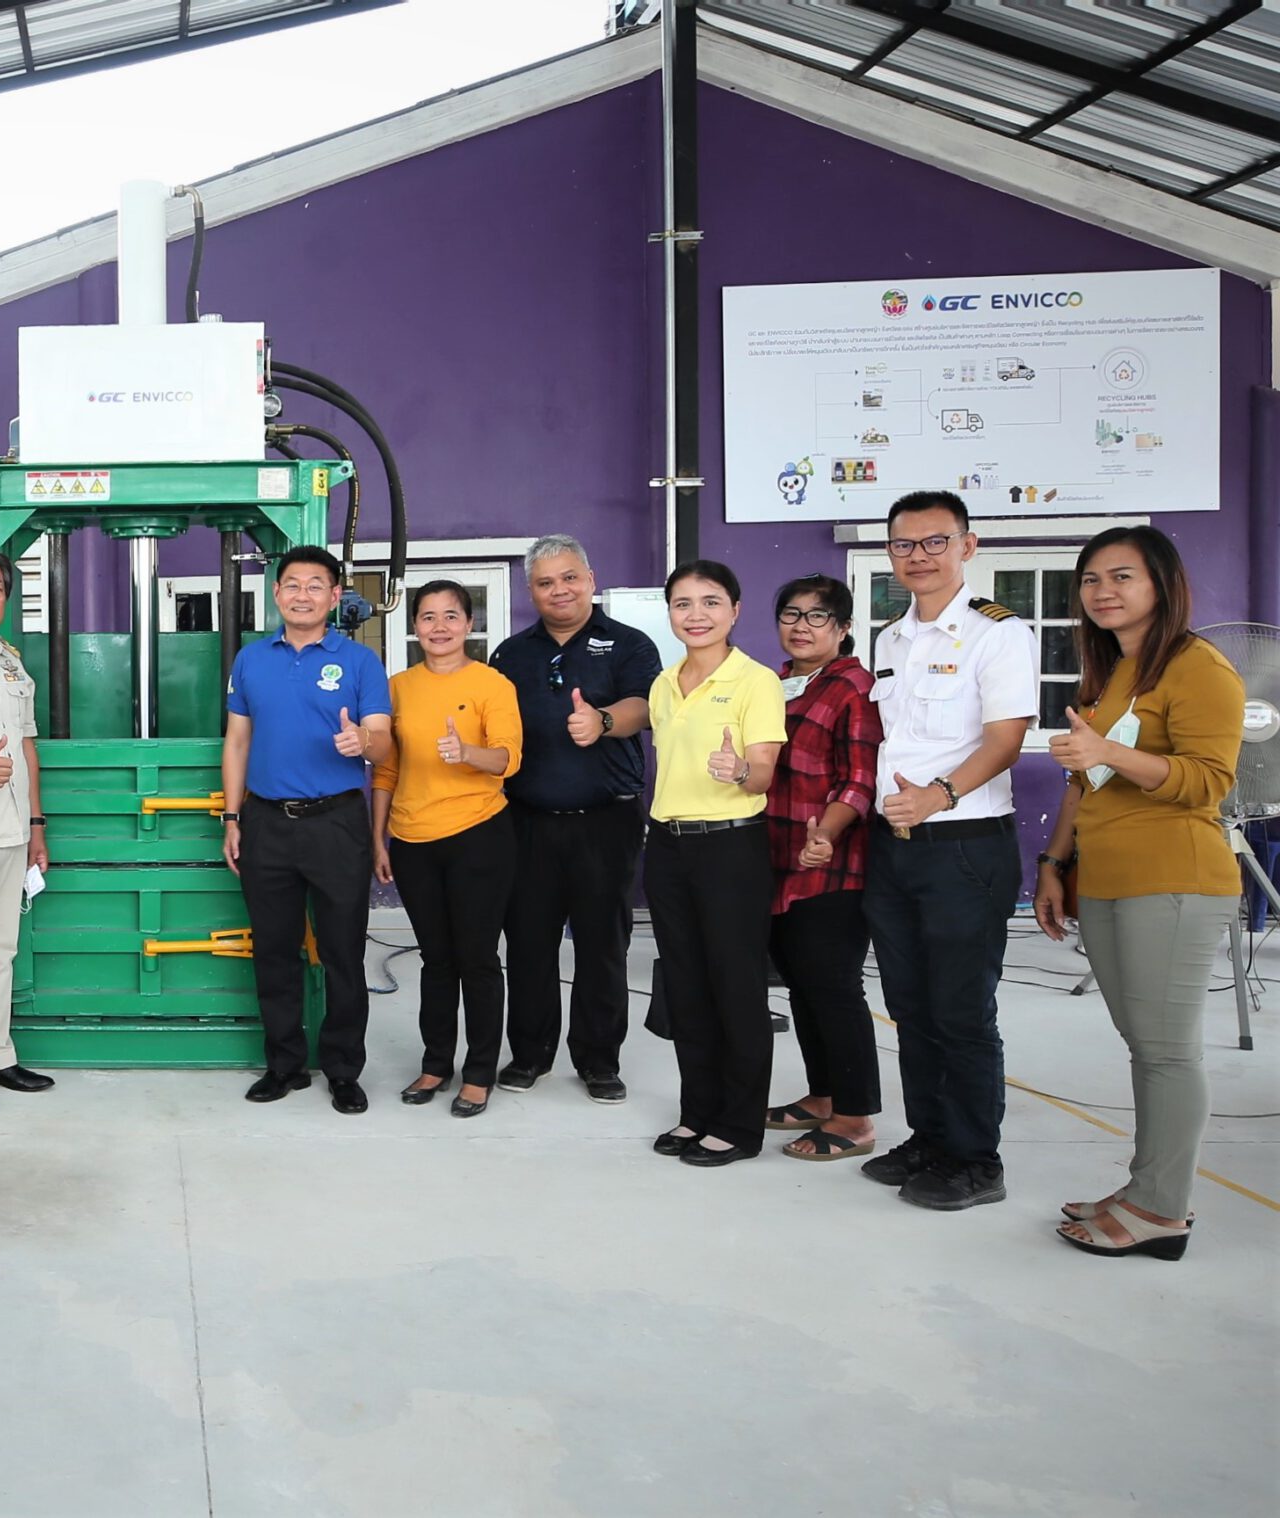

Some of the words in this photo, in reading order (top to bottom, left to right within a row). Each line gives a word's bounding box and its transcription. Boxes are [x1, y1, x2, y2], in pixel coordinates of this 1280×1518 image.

[939, 295, 981, 311] GC
[991, 292, 1083, 309] ENVICCO
[98, 392, 126, 402] GC
[132, 391, 194, 403] ENVICCO
